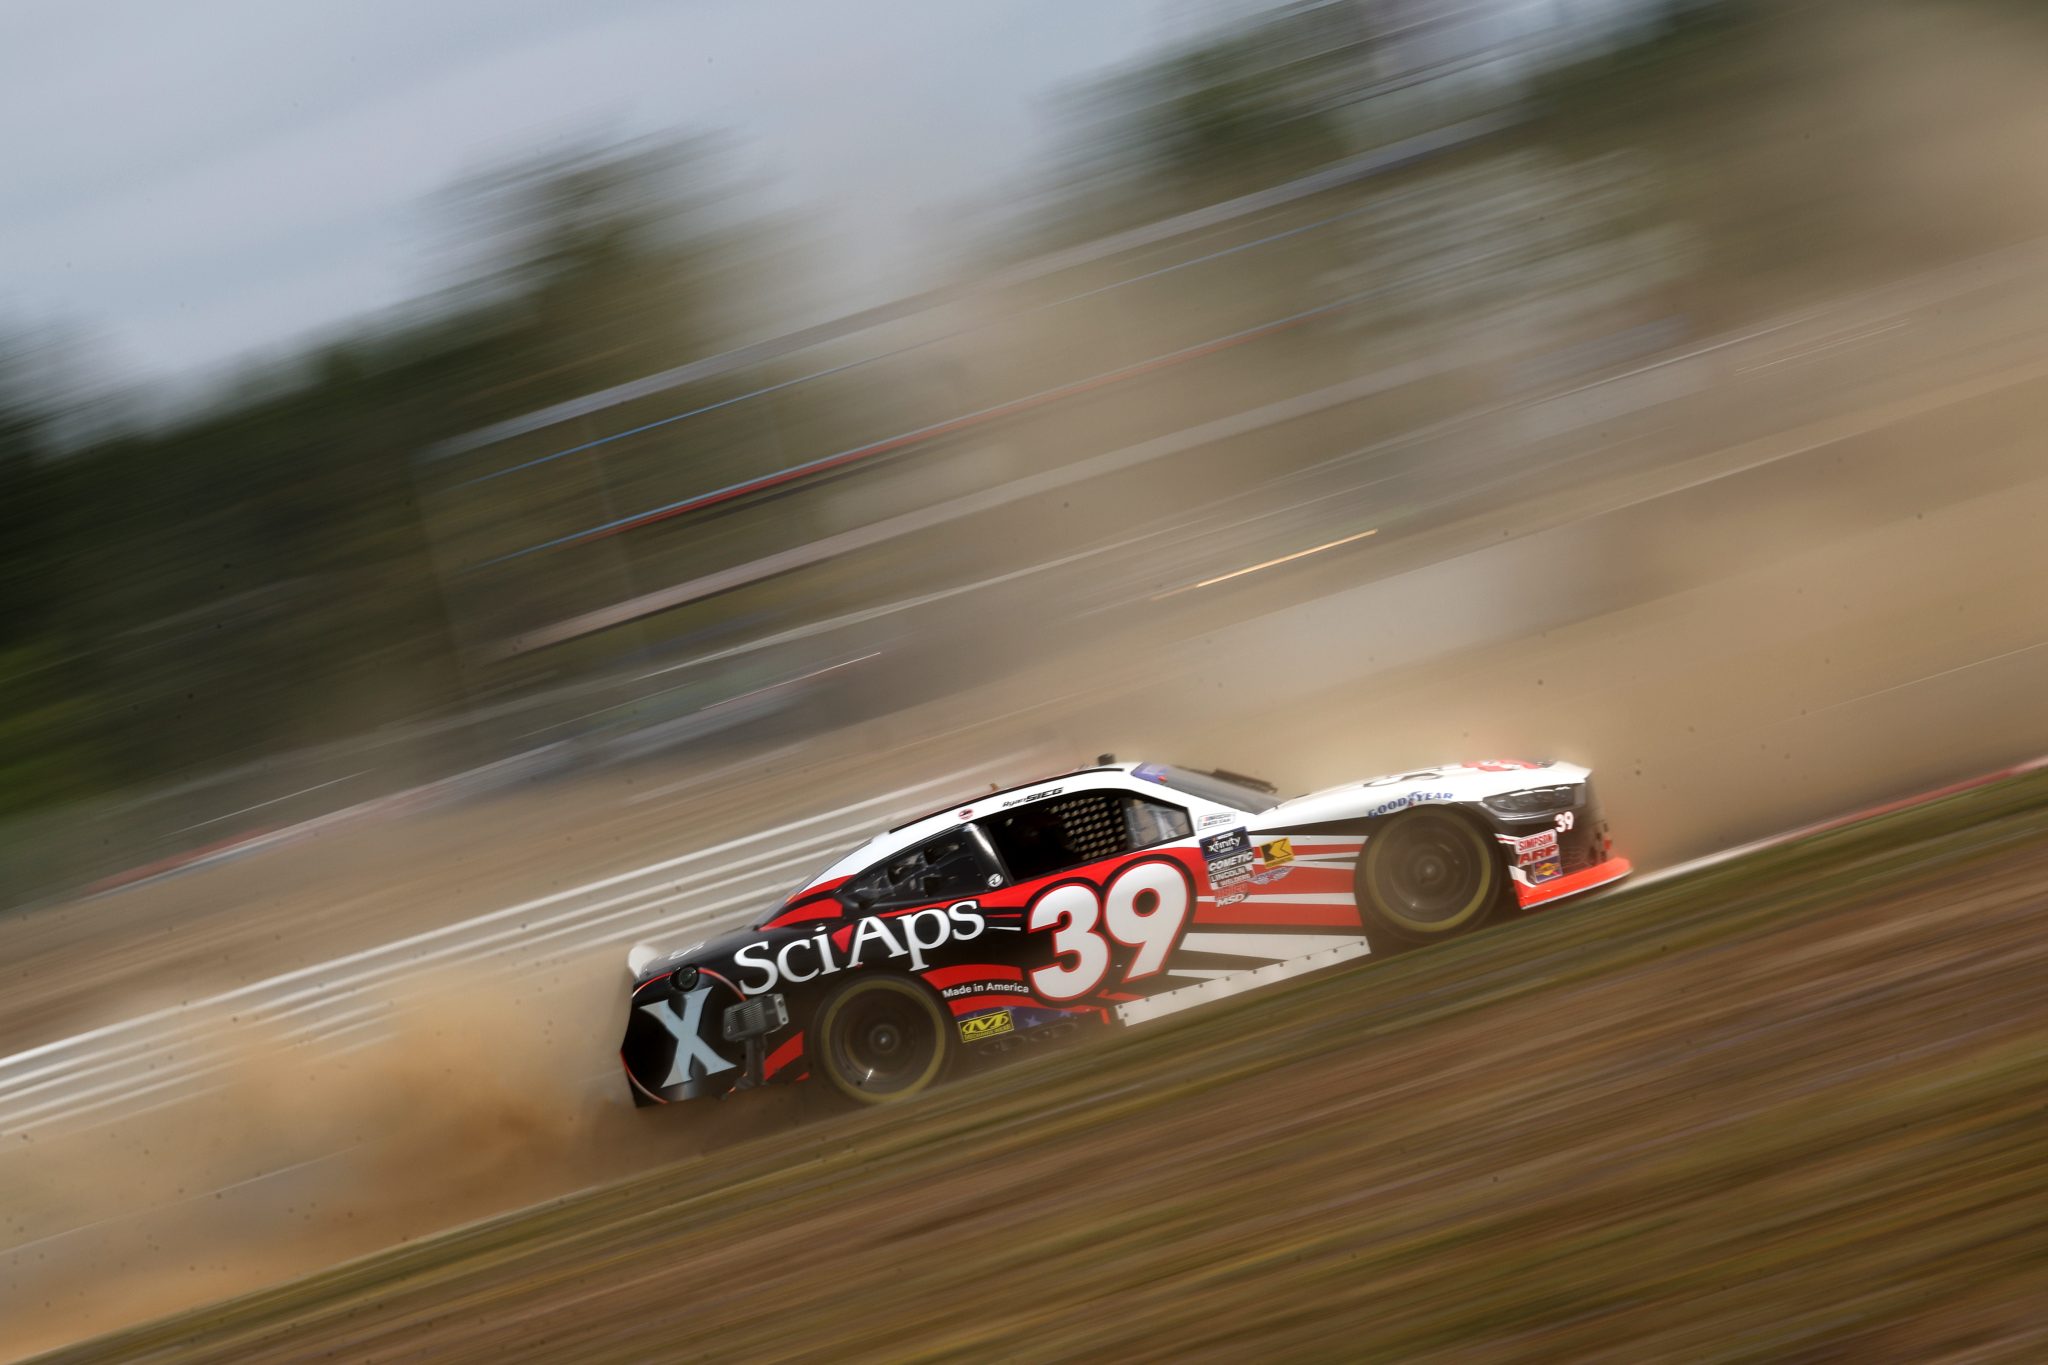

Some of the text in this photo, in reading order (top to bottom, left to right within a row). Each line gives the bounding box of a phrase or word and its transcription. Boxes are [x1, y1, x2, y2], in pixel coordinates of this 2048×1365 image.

[1367, 791, 1453, 818] GOODYEAR
[1554, 811, 1574, 833] 39
[1208, 837, 1241, 853] xfinity
[1519, 833, 1553, 851] SIMPSON
[1209, 851, 1254, 871] COMETIC
[1520, 845, 1558, 865] ARP
[1211, 866, 1246, 882] LINCOLN
[1216, 893, 1245, 907] MSD
[1028, 860, 1190, 1000] 39
[942, 982, 1030, 998] Made in America
[638, 986, 737, 1089] X
